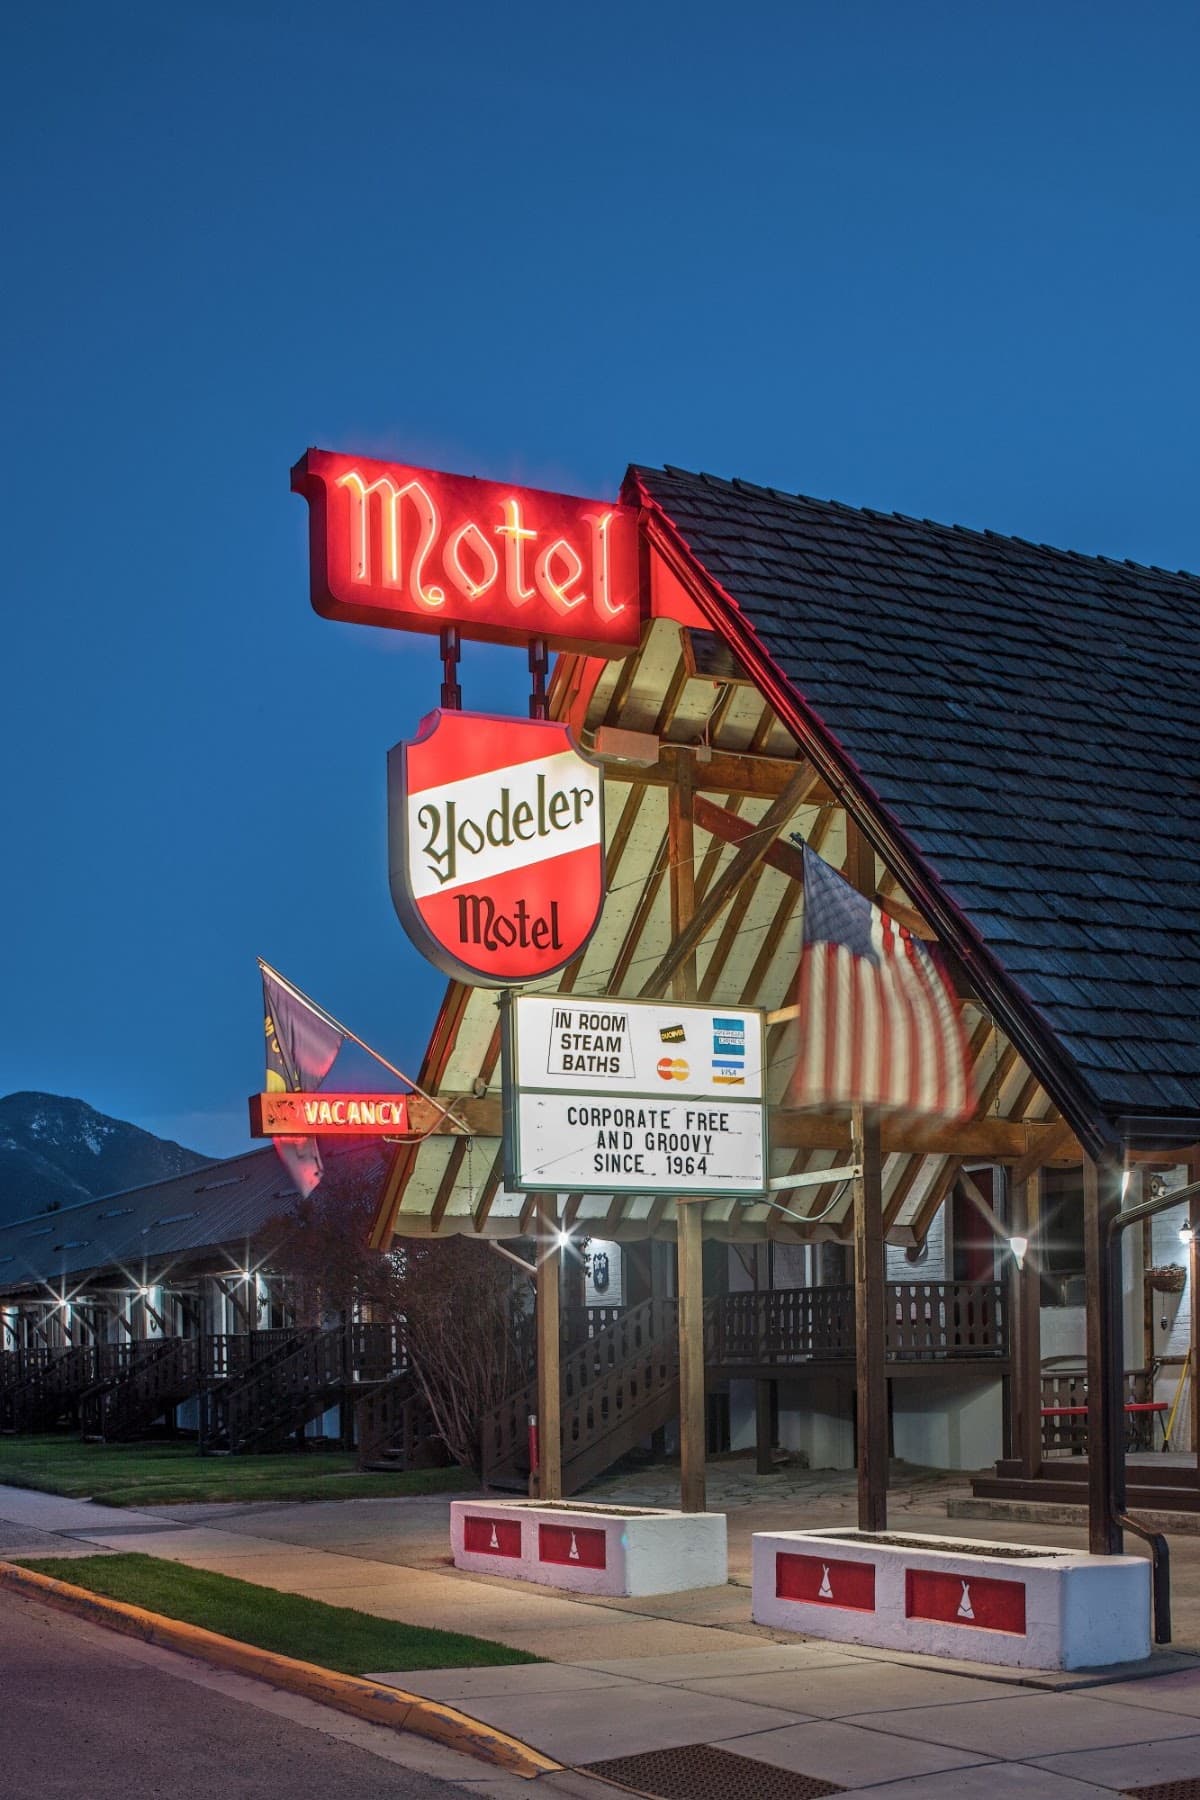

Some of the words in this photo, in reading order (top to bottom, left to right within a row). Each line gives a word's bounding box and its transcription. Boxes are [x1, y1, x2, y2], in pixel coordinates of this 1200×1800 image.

[335, 469, 624, 623] Motel
[418, 774, 594, 885] Yodeler
[453, 894, 563, 951] Motel
[555, 1012, 572, 1029] IN
[579, 1013, 626, 1032] ROOM
[561, 1033, 622, 1053] STEAM
[562, 1054, 620, 1073] BATHS
[305, 1100, 403, 1125] VACANCY
[567, 1106, 671, 1129] CORPORATE
[686, 1111, 729, 1132] FREE
[597, 1130, 633, 1150] AND
[645, 1132, 712, 1154] GROOVY
[594, 1153, 645, 1173] SINCE
[666, 1155, 707, 1175] 1964
